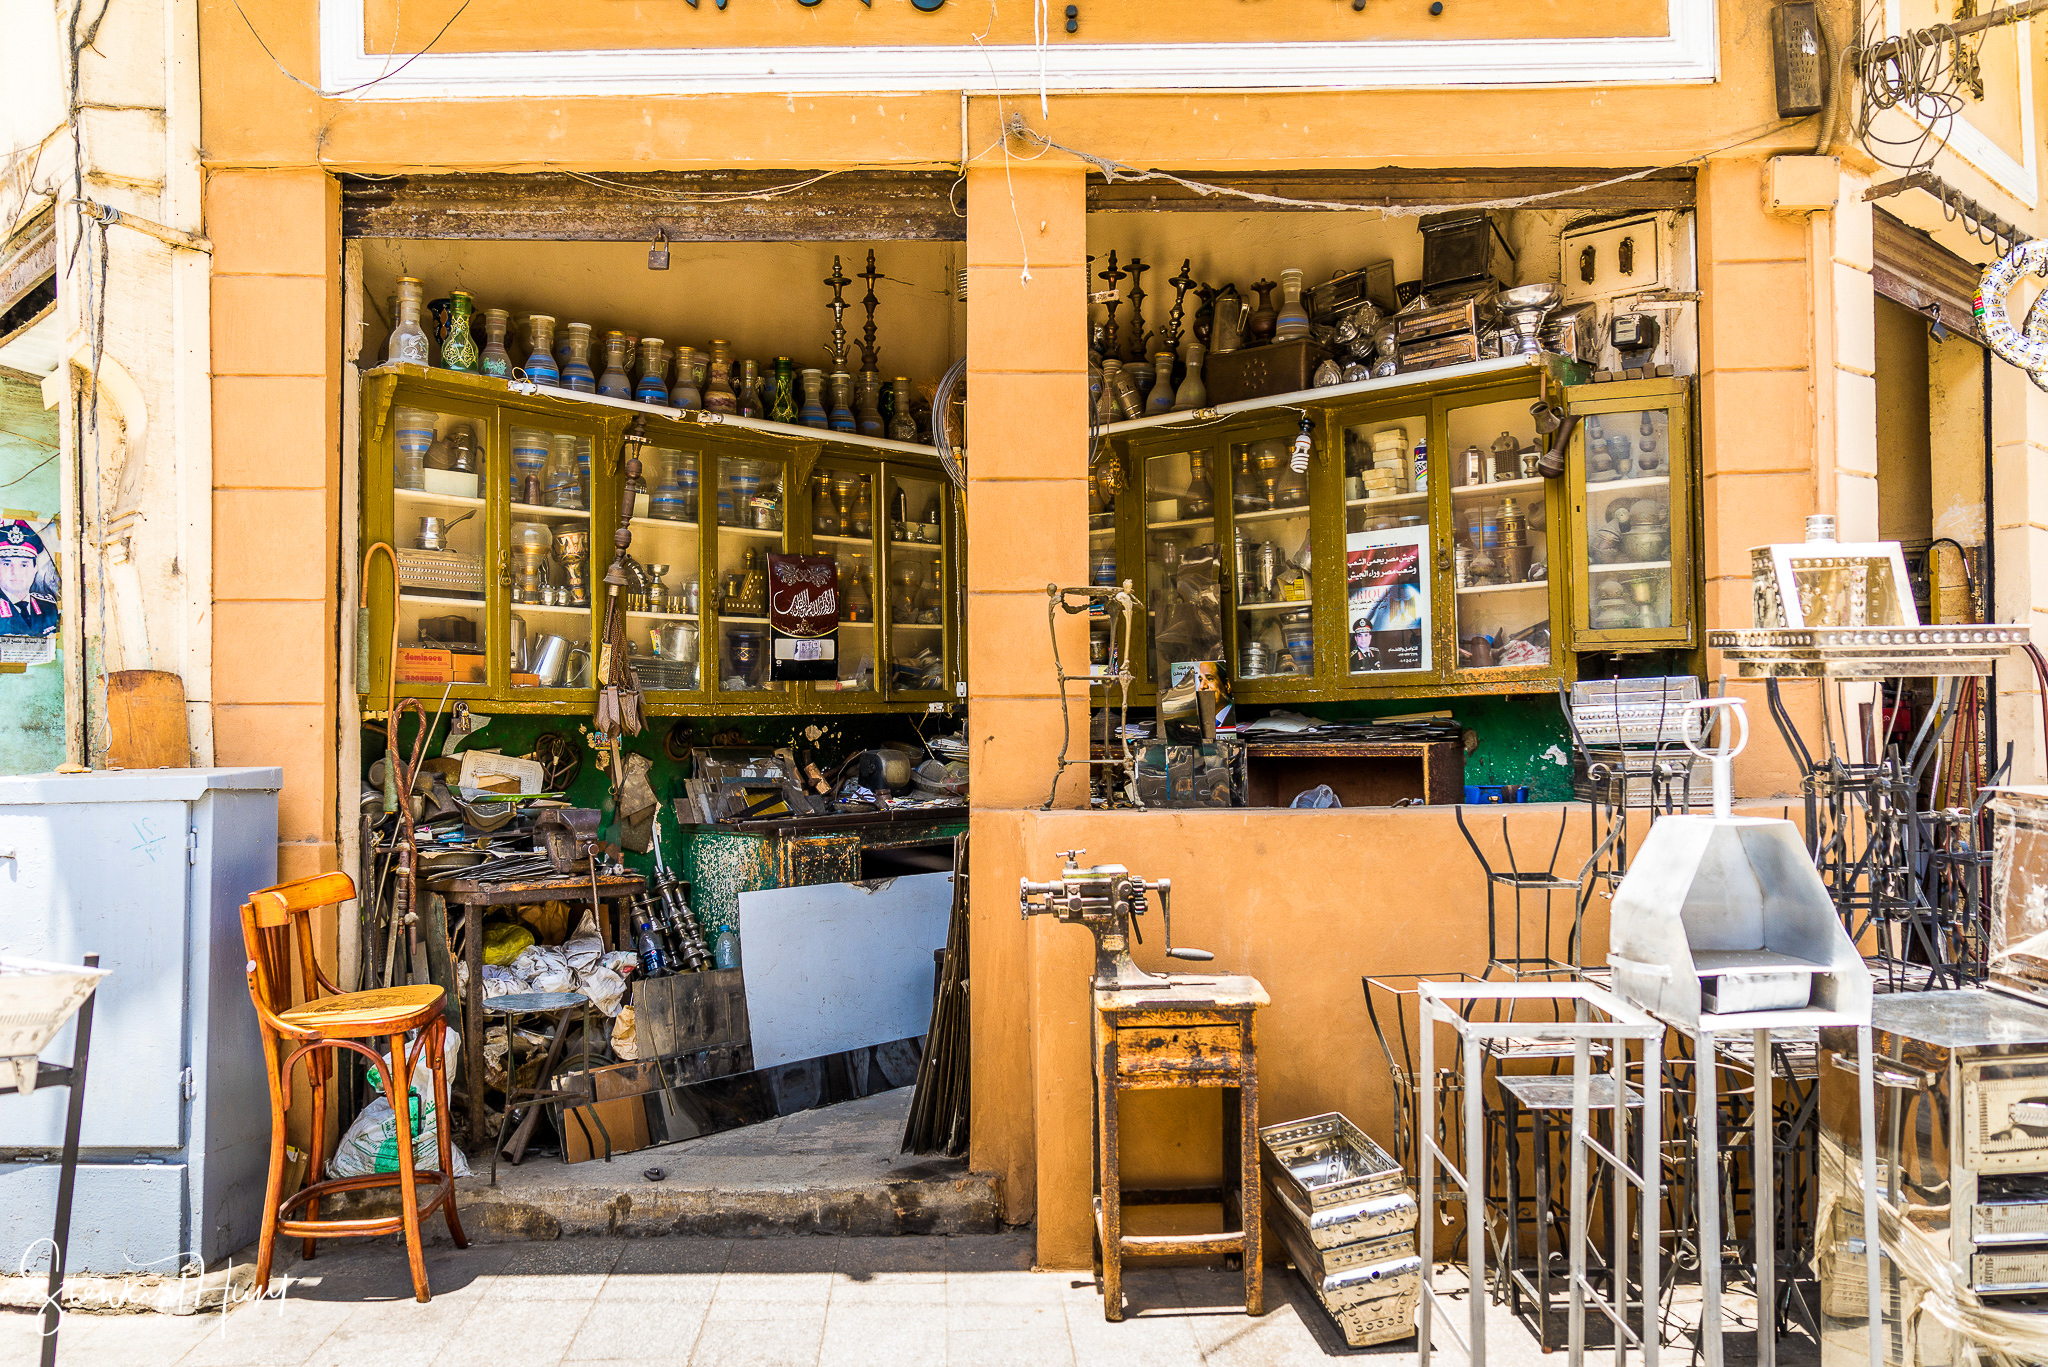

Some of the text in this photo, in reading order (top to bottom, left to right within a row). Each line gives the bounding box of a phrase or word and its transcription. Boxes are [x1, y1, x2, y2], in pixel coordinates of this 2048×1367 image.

[1347, 558, 1366, 568] الشعب
[1385, 556, 1399, 564] مصر
[1347, 570, 1369, 581] الجيش
[1380, 569, 1395, 578] مصر
